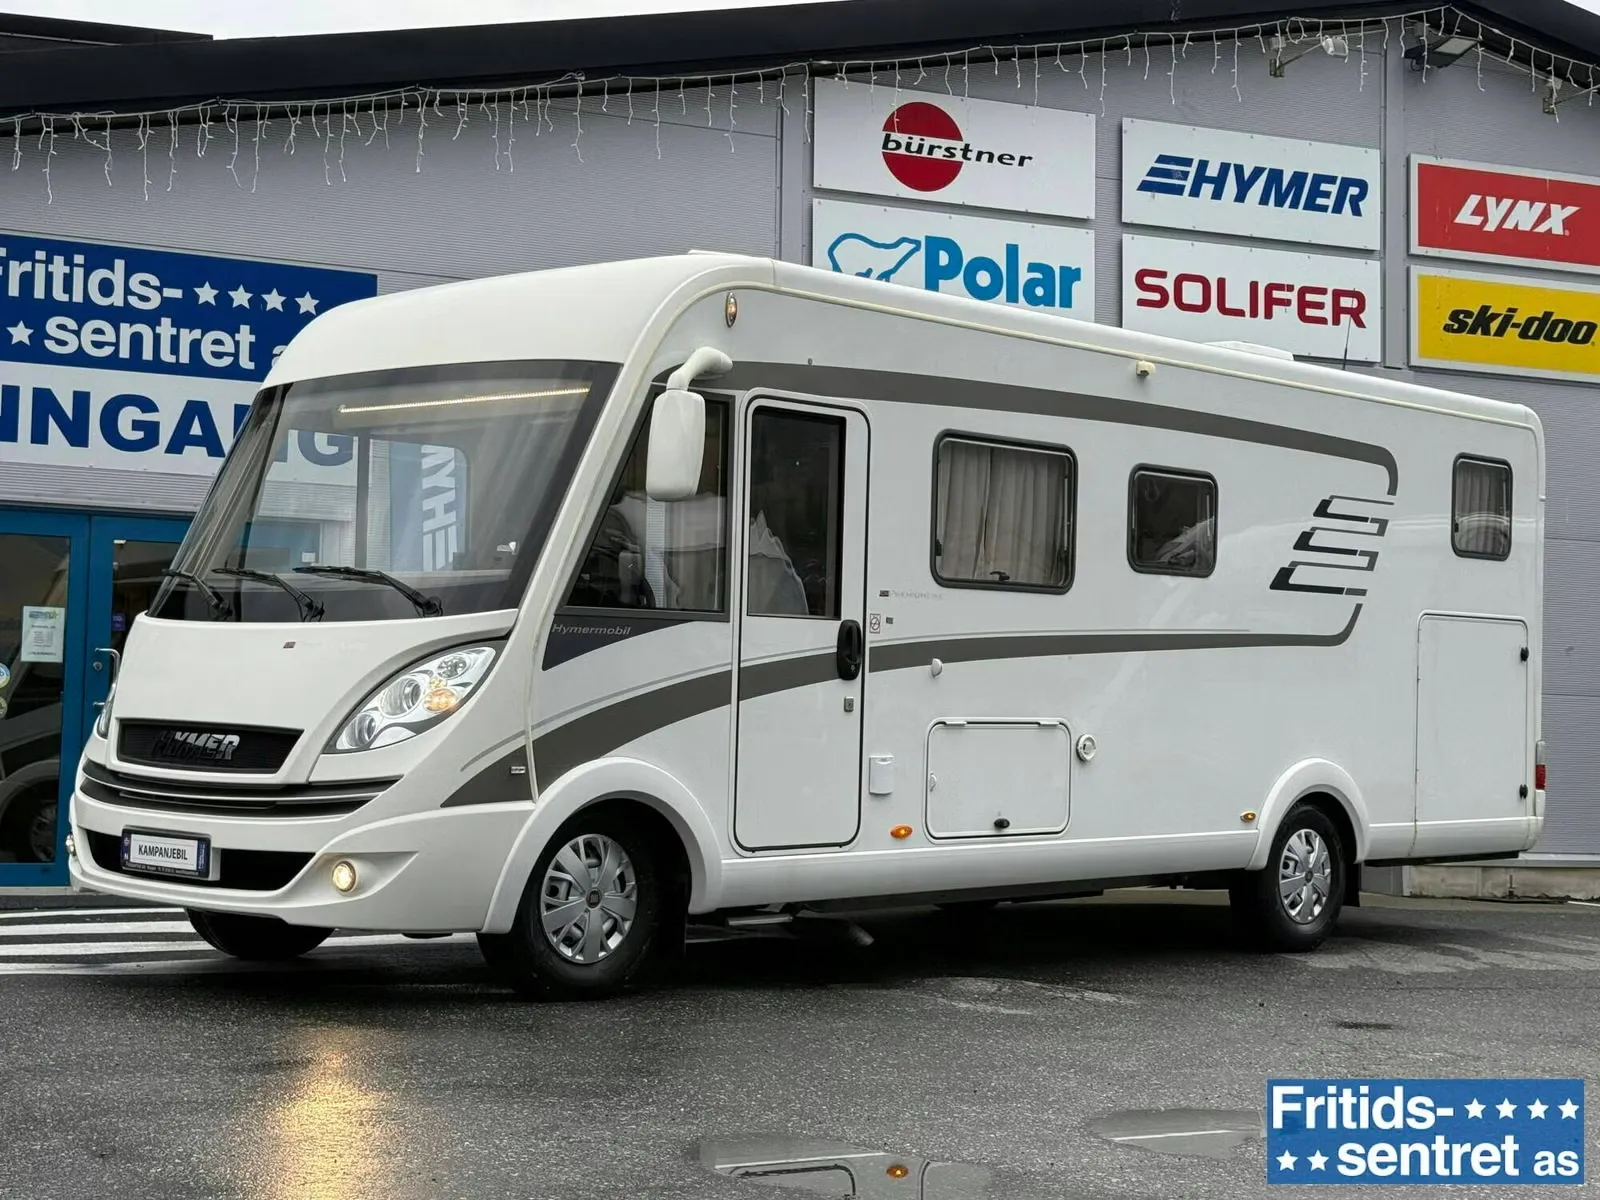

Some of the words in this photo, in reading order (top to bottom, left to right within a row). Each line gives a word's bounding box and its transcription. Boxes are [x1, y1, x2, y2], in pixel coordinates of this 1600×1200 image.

[881, 133, 1034, 168] bürstner
[1187, 158, 1369, 217] HYMER
[1453, 194, 1580, 236] LYNX
[0, 247, 184, 310] ritids-
[923, 234, 1084, 311] Polar
[1135, 269, 1367, 329] SOLIFER
[43, 316, 256, 370] sentret
[1442, 304, 1598, 346] ski-doo
[551, 623, 632, 636] Hymermobil
[137, 844, 189, 861] KAMPANJEBIL
